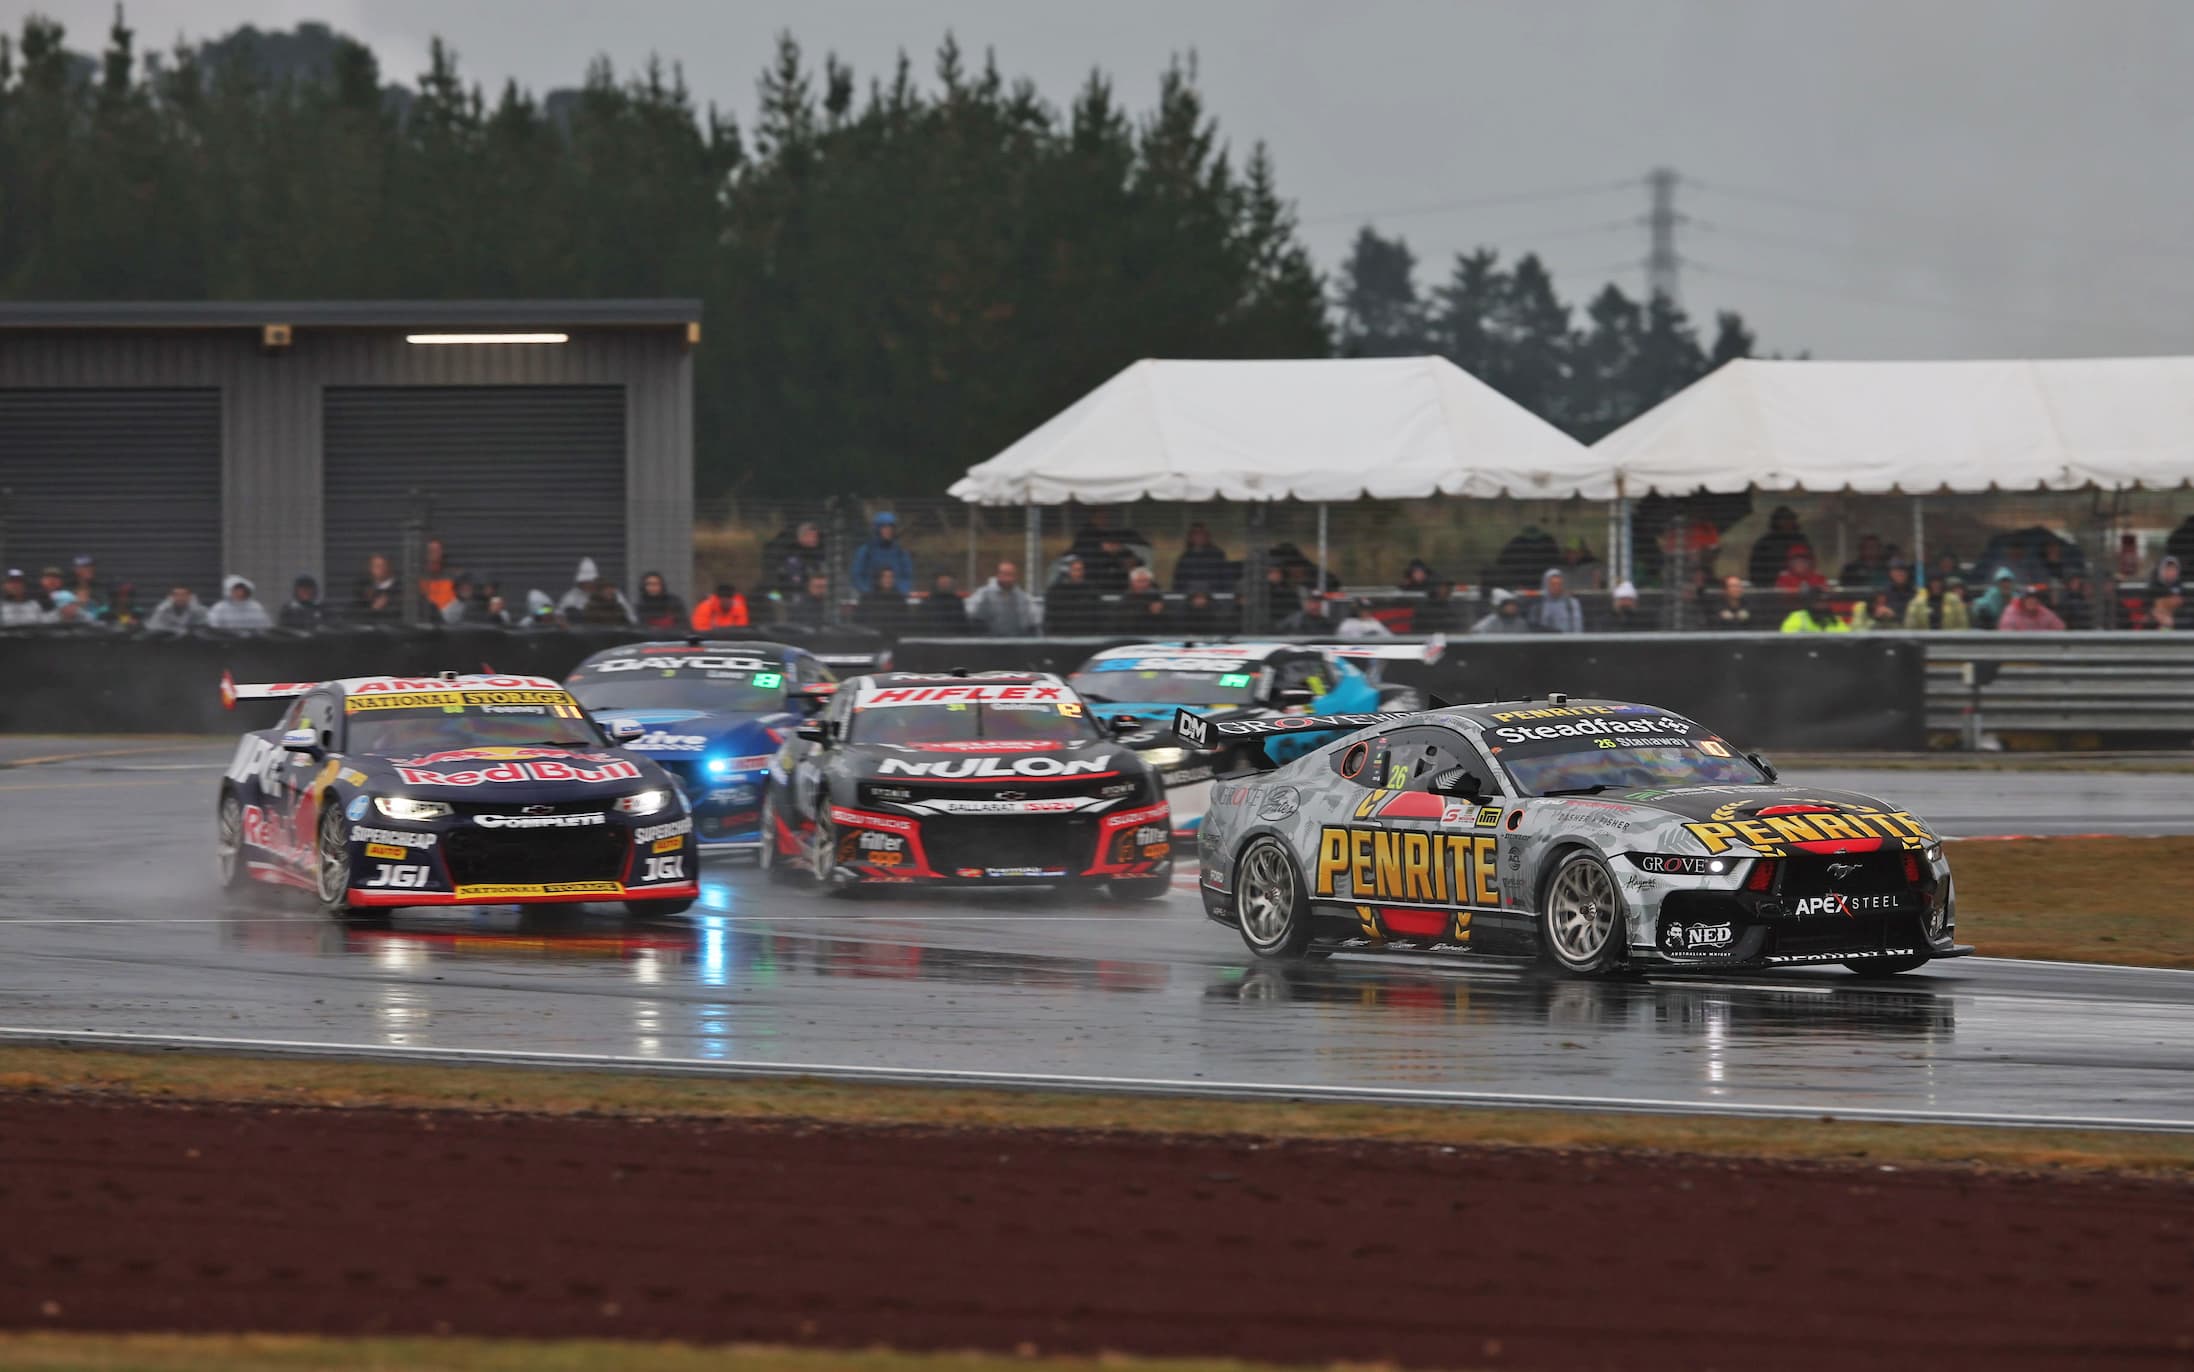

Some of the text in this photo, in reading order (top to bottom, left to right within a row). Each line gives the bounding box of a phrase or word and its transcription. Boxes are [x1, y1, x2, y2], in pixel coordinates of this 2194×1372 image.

[590, 656, 780, 673] DAYCO
[355, 677, 556, 694] AMPOL
[350, 691, 563, 709] NATIONAL STORAGE
[869, 687, 1061, 704] HIFLEX
[1491, 705, 1616, 723] PENRITE
[1217, 714, 1377, 734] GROVE
[1495, 717, 1665, 744] Steadfast
[1593, 736, 1690, 749] 26 Stanaway
[1699, 739, 1731, 758] 10
[397, 761, 643, 786] Red Bull
[878, 756, 1112, 778] NULON
[1386, 765, 1408, 789] 26
[947, 802, 1076, 812] BALLARAT ISUZU
[473, 811, 607, 829] COMPLETE
[1682, 810, 1934, 855] PENRITE
[641, 855, 685, 881] JGI
[1316, 827, 1500, 905] PENRITE
[1642, 856, 1706, 873] GROVE
[367, 864, 431, 888] JGI
[461, 882, 617, 895] NATIONAL STORAGE
[1795, 893, 1899, 919] APEX STEEL
[1689, 927, 1732, 944] NED
